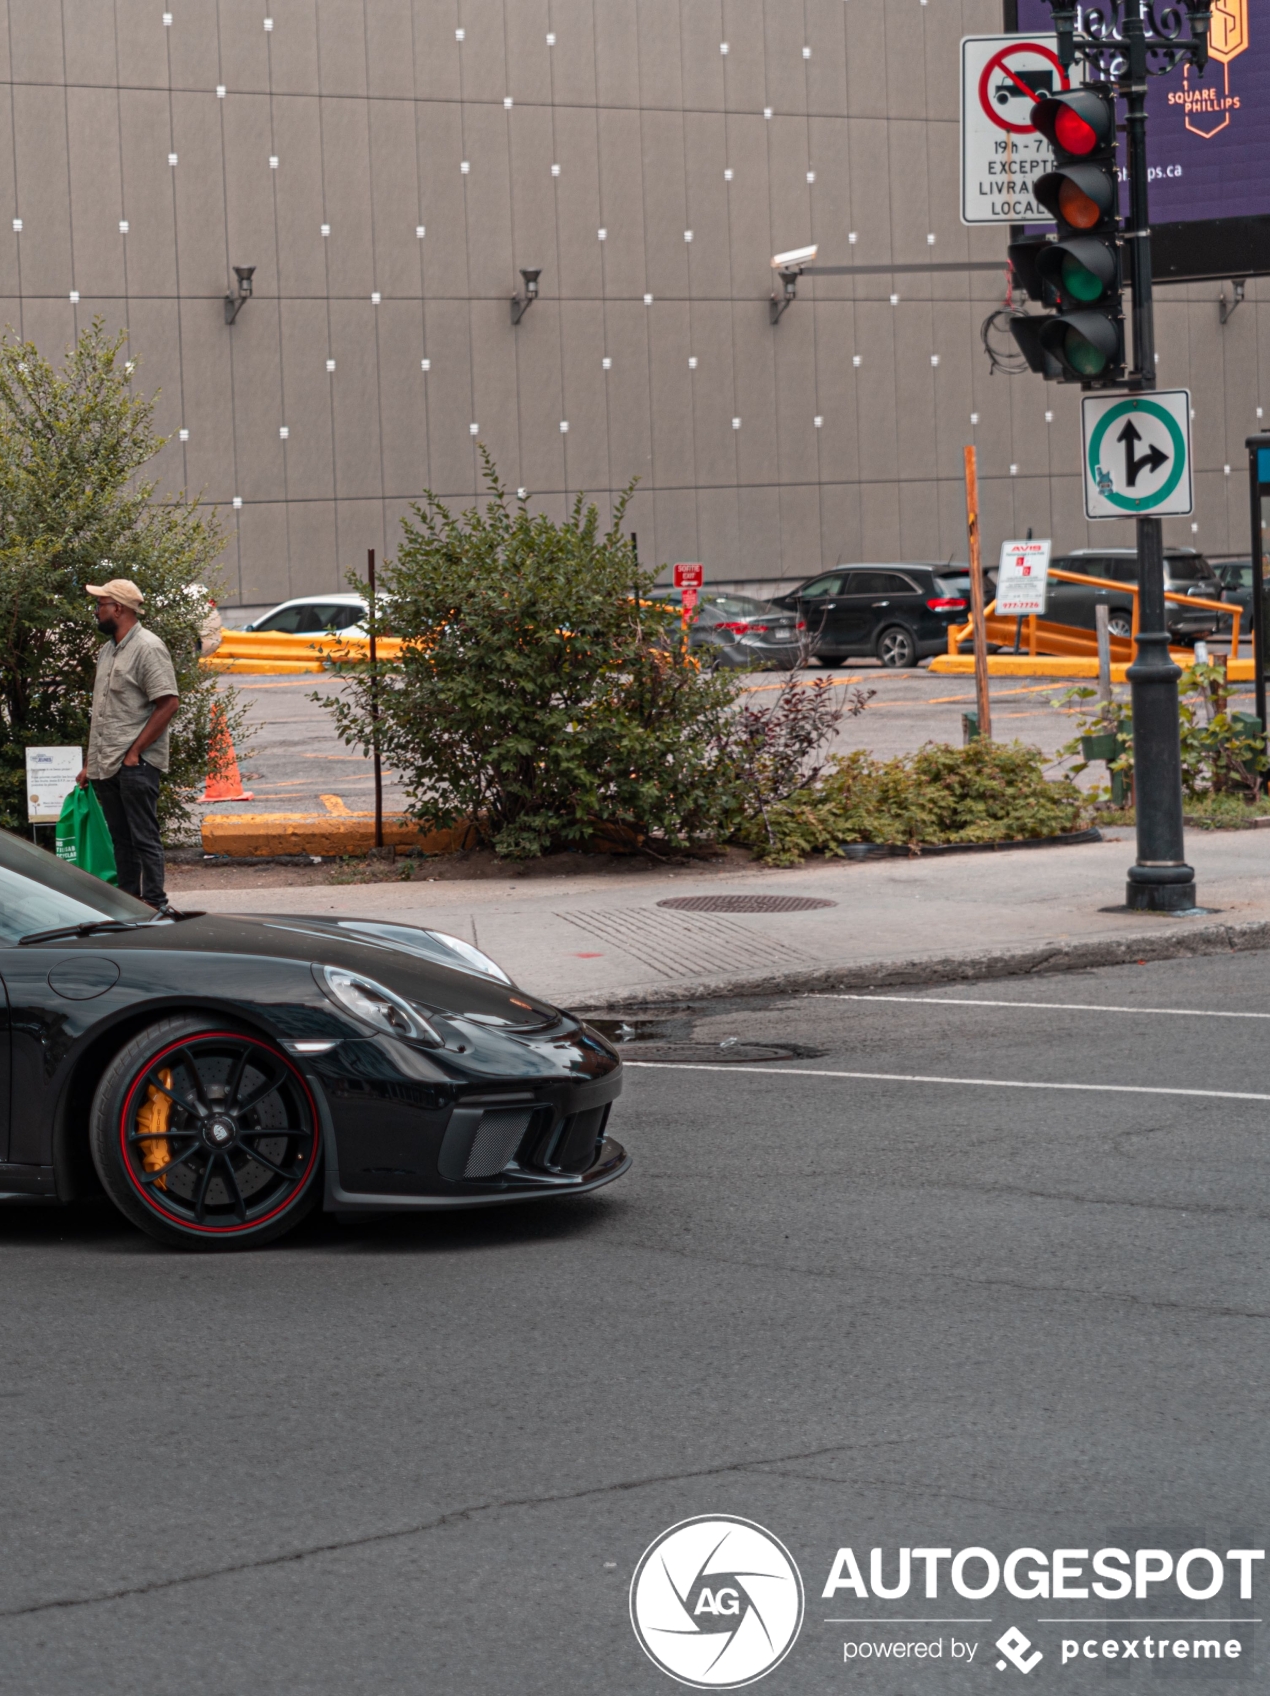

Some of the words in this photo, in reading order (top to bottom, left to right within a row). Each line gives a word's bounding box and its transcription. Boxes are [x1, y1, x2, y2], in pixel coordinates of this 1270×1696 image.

[1168, 88, 1216, 105] SQUARE
[1185, 96, 1241, 114] PHILLIPS
[992, 201, 1050, 216] LOCAL
